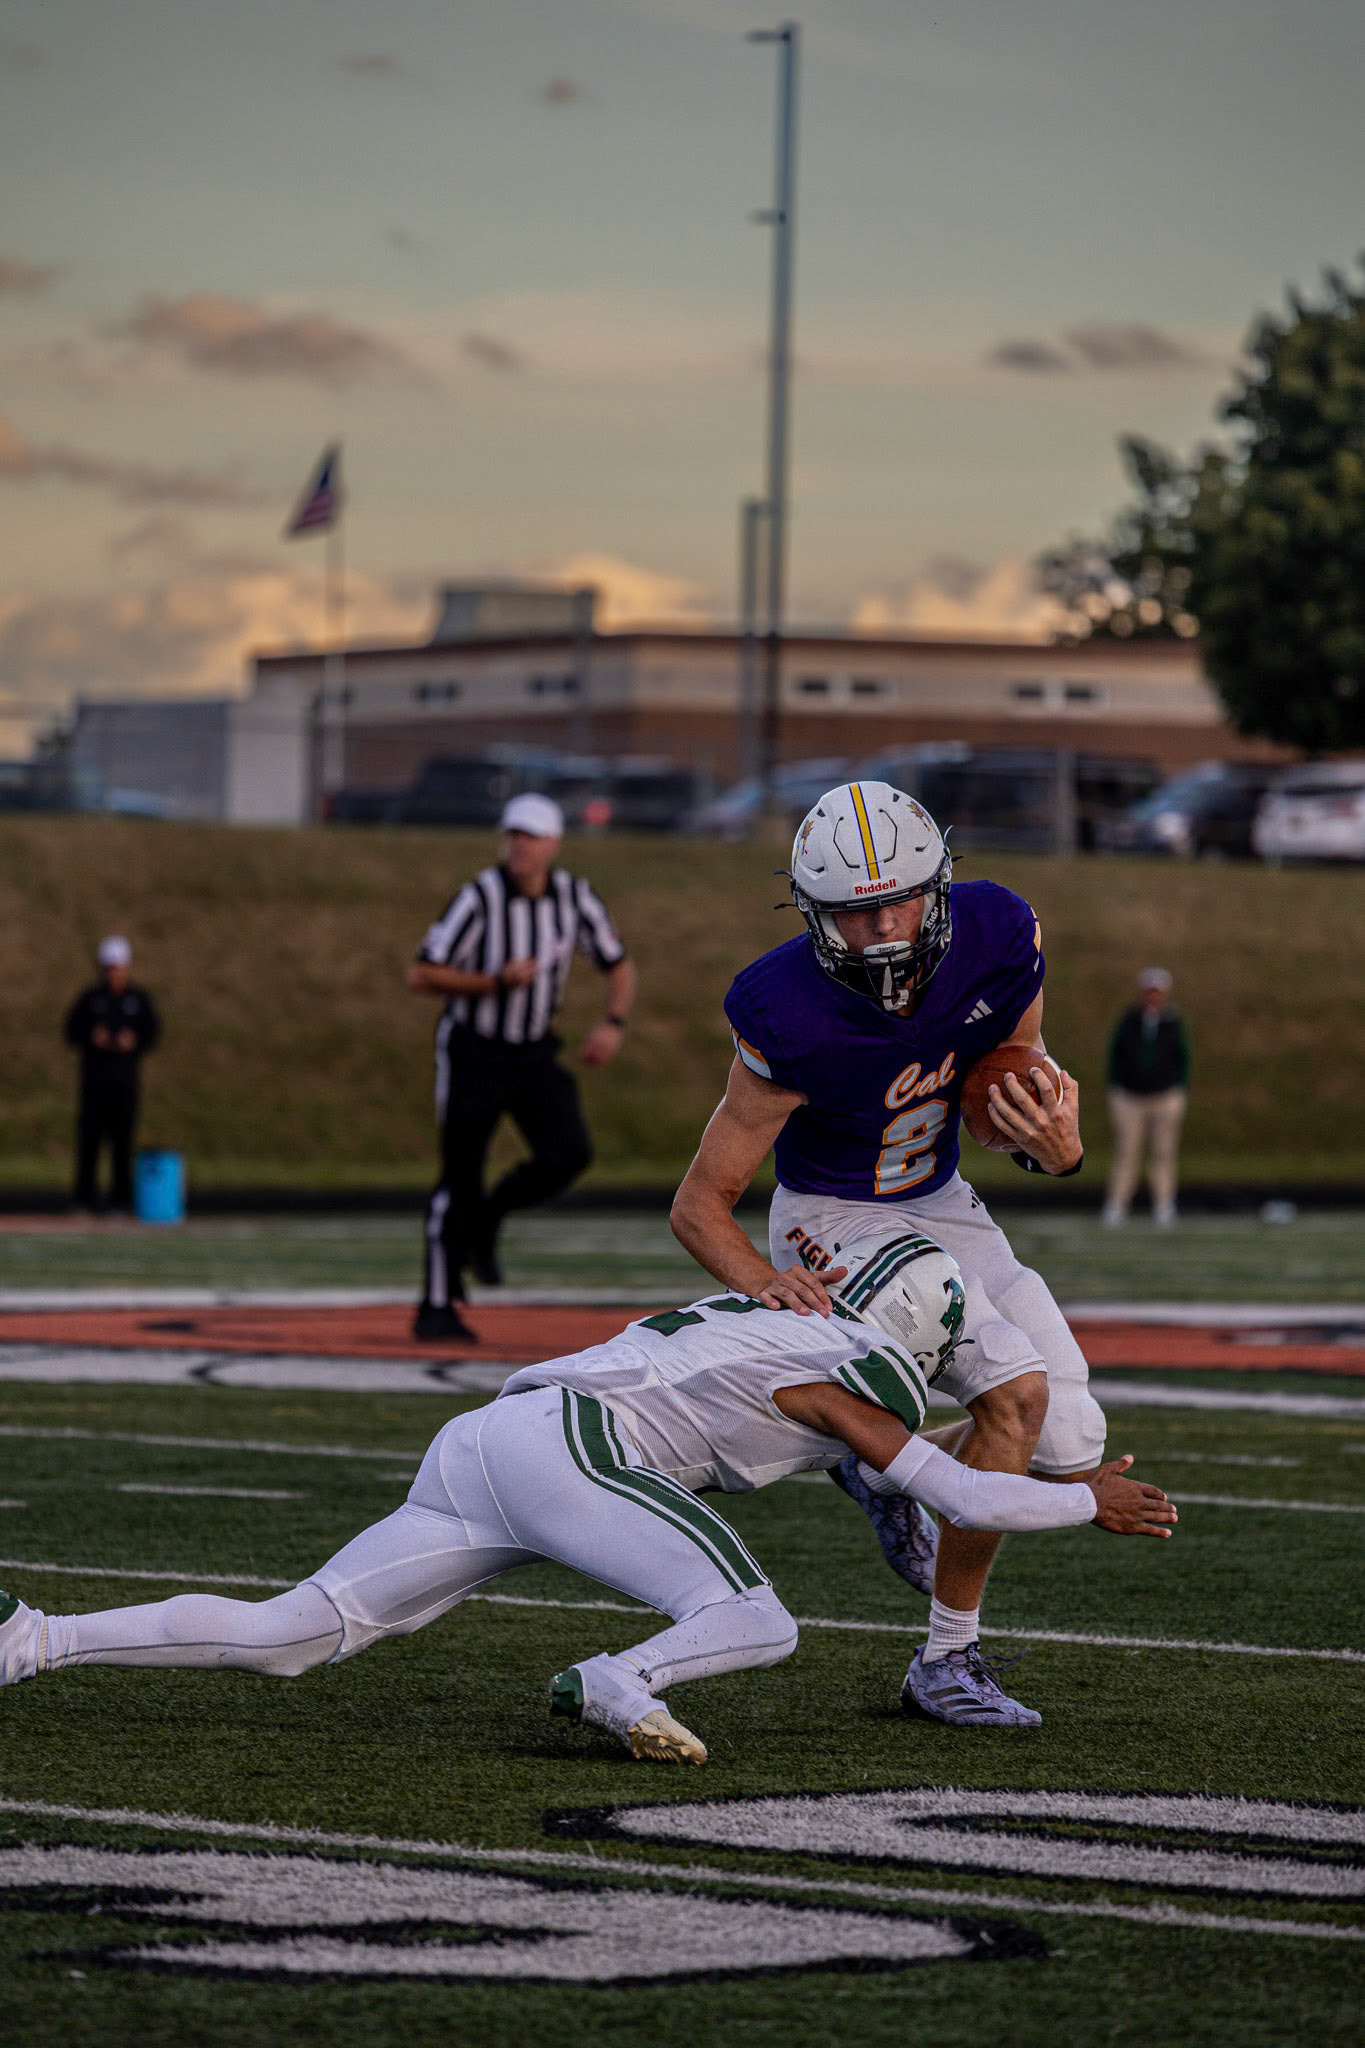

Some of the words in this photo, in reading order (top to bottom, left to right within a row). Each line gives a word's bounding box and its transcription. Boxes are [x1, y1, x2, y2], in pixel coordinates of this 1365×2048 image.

[854, 878, 897, 896] Riddell
[885, 1052, 955, 1109] Cal
[874, 1099, 948, 1195] 2
